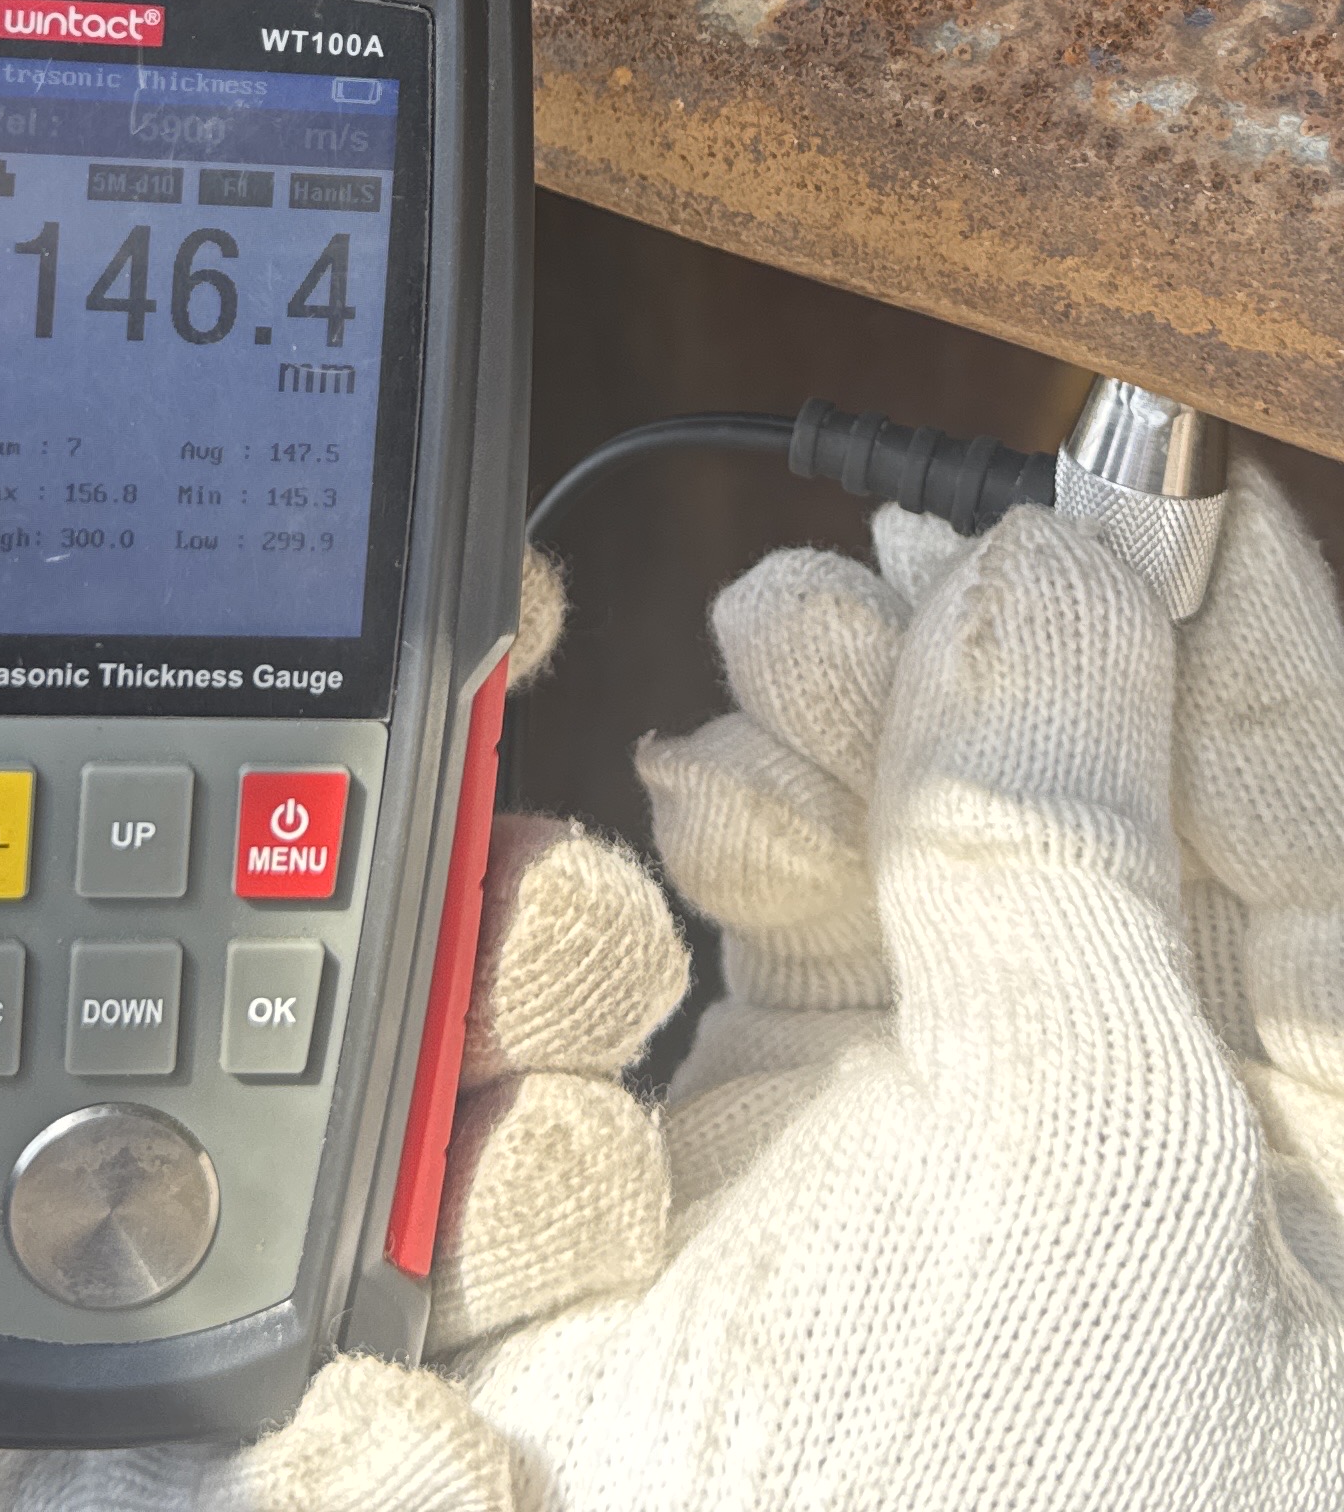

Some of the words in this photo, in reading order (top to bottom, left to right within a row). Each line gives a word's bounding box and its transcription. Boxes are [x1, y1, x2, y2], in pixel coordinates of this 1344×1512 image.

[260, 28, 385, 58] WT100A
[137, 68, 269, 96] Thickness
[140, 112, 226, 143] 5900
[304, 124, 369, 152] m/s
[14, 221, 356, 348] 146.4
[278, 361, 356, 395] mm
[67, 437, 82, 457] 7
[270, 443, 340, 463] 147.5
[65, 483, 138, 504] 156.8
[267, 487, 338, 508] 145.3
[60, 527, 135, 549] 300.0
[262, 531, 335, 552] 299.9
[98, 662, 244, 688] Thickness
[253, 664, 344, 694] Gauge
[110, 822, 156, 848] UP
[247, 846, 328, 873] MENU
[82, 999, 163, 1024] DOWN
[247, 997, 296, 1023] OK
